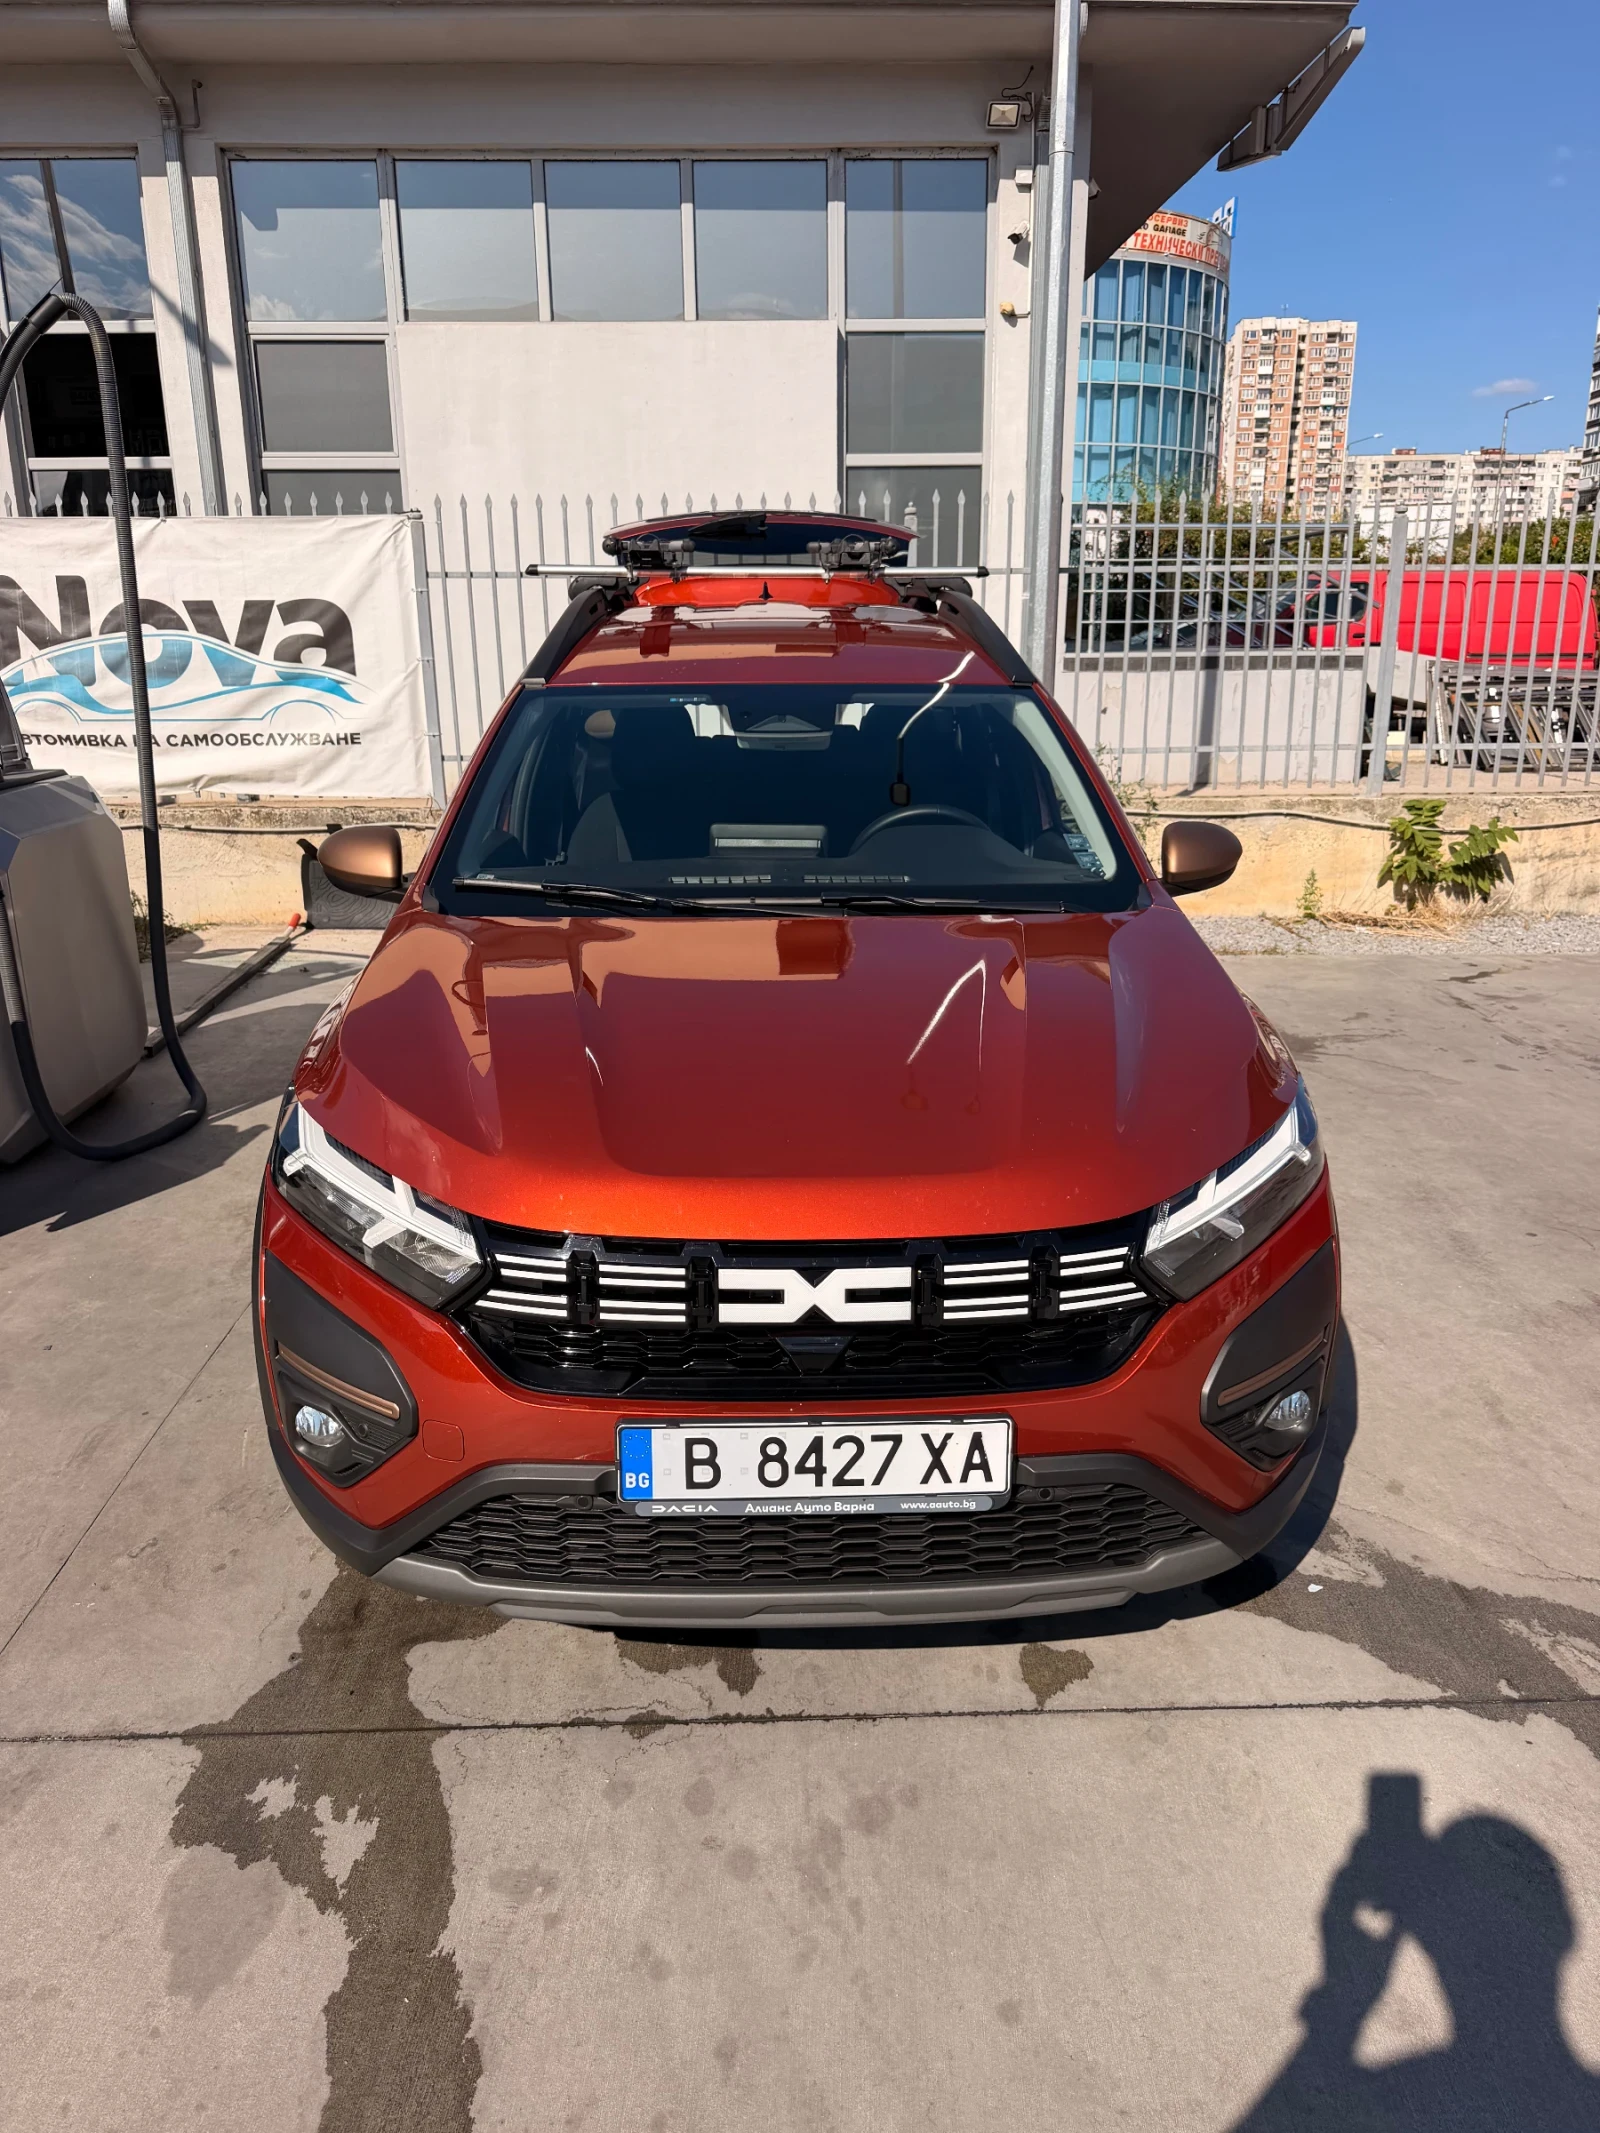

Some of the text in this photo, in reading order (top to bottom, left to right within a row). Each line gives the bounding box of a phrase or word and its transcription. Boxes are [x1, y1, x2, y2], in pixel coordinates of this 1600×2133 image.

[1153, 224, 1187, 236] GARAGE
[1134, 232, 1204, 260] ТЕХНИЧЕСКИ
[0, 575, 357, 688] Nova
[21, 733, 127, 748] ВТОМИВКА
[166, 732, 362, 748] САМООБСЛУЖВАНЕ
[757, 1434, 903, 1489] 8427
[625, 1472, 650, 1489] BG
[651, 1504, 719, 1513] DACIA
[744, 1503, 792, 1513] Алианс
[834, 1501, 875, 1514] Варна
[900, 1499, 977, 1510] www.aauto.bg
